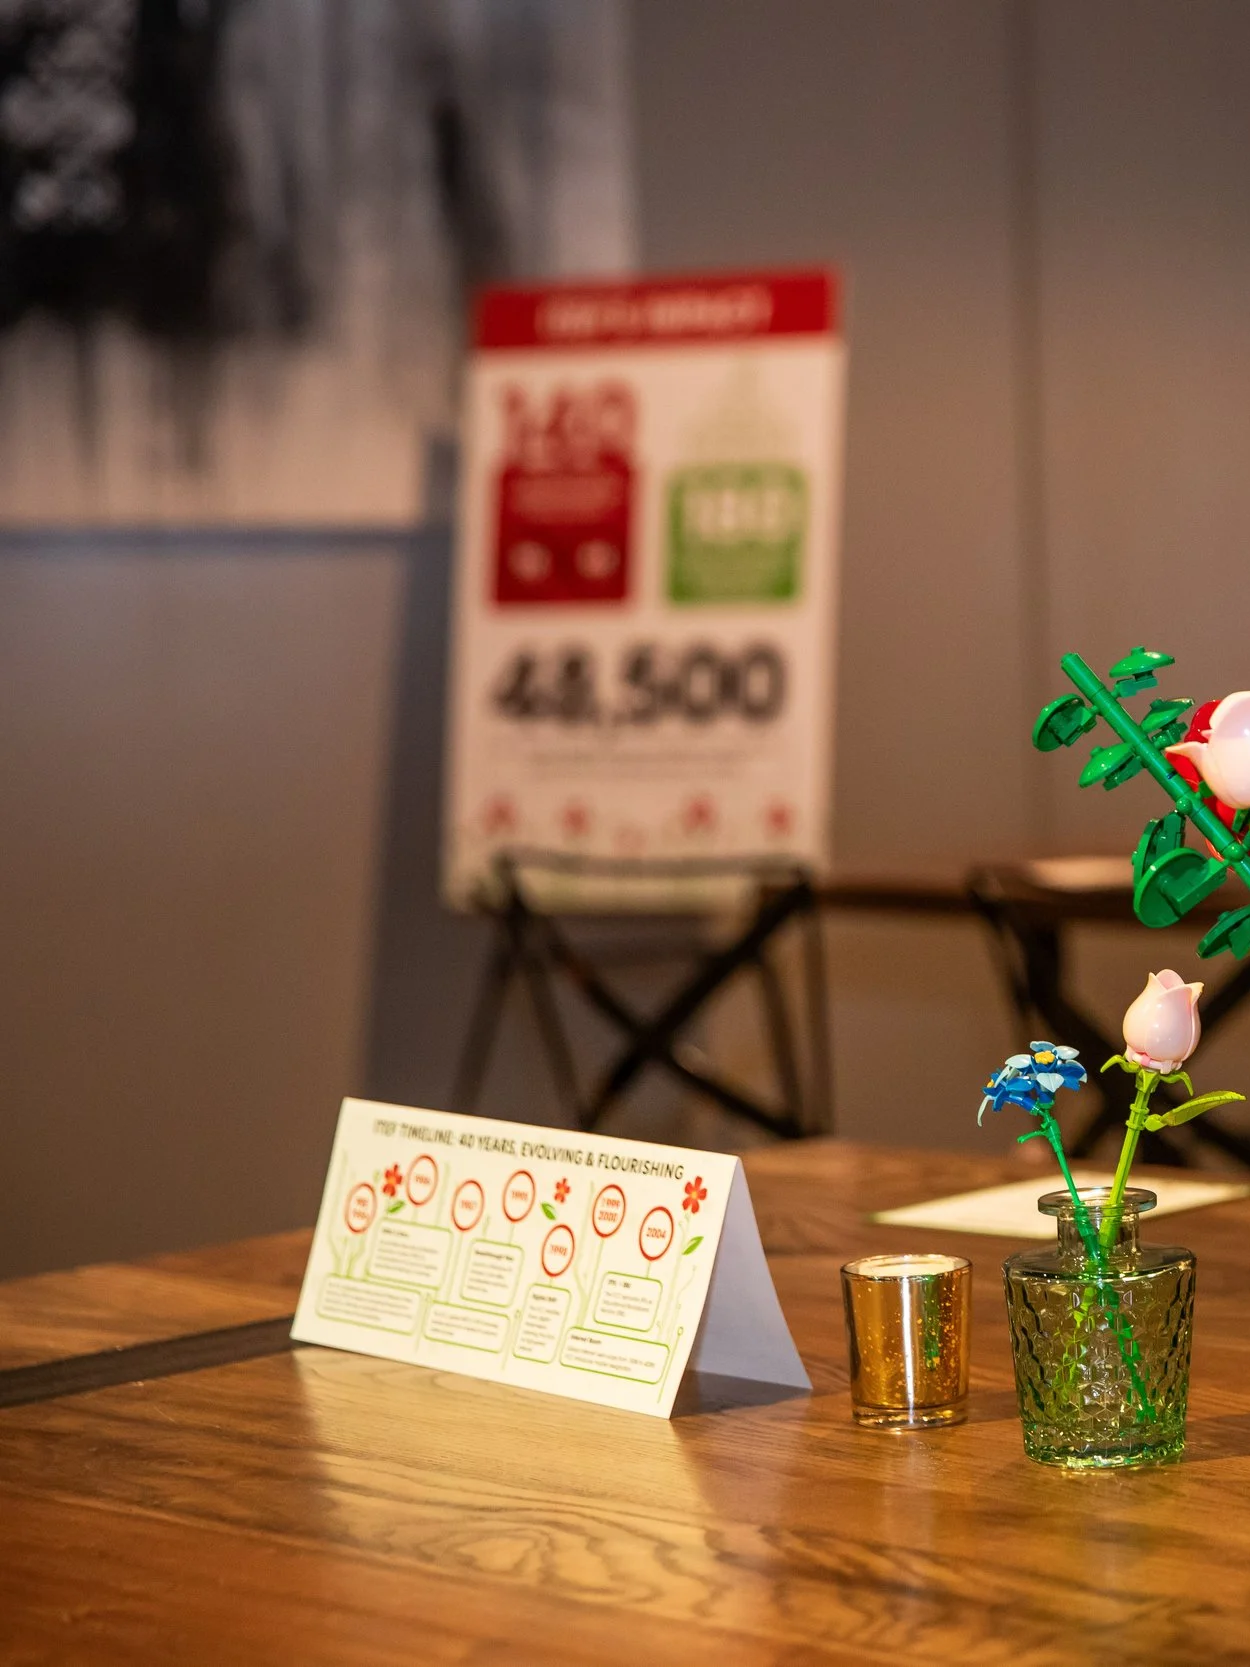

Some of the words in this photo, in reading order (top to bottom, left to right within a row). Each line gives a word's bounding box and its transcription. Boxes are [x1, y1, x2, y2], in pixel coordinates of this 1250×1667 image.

[521, 1141, 583, 1165] EVOLVING
[586, 1151, 596, 1167] &
[598, 1153, 685, 1181] FLOURISHING
[645, 1226, 667, 1240] 2004
